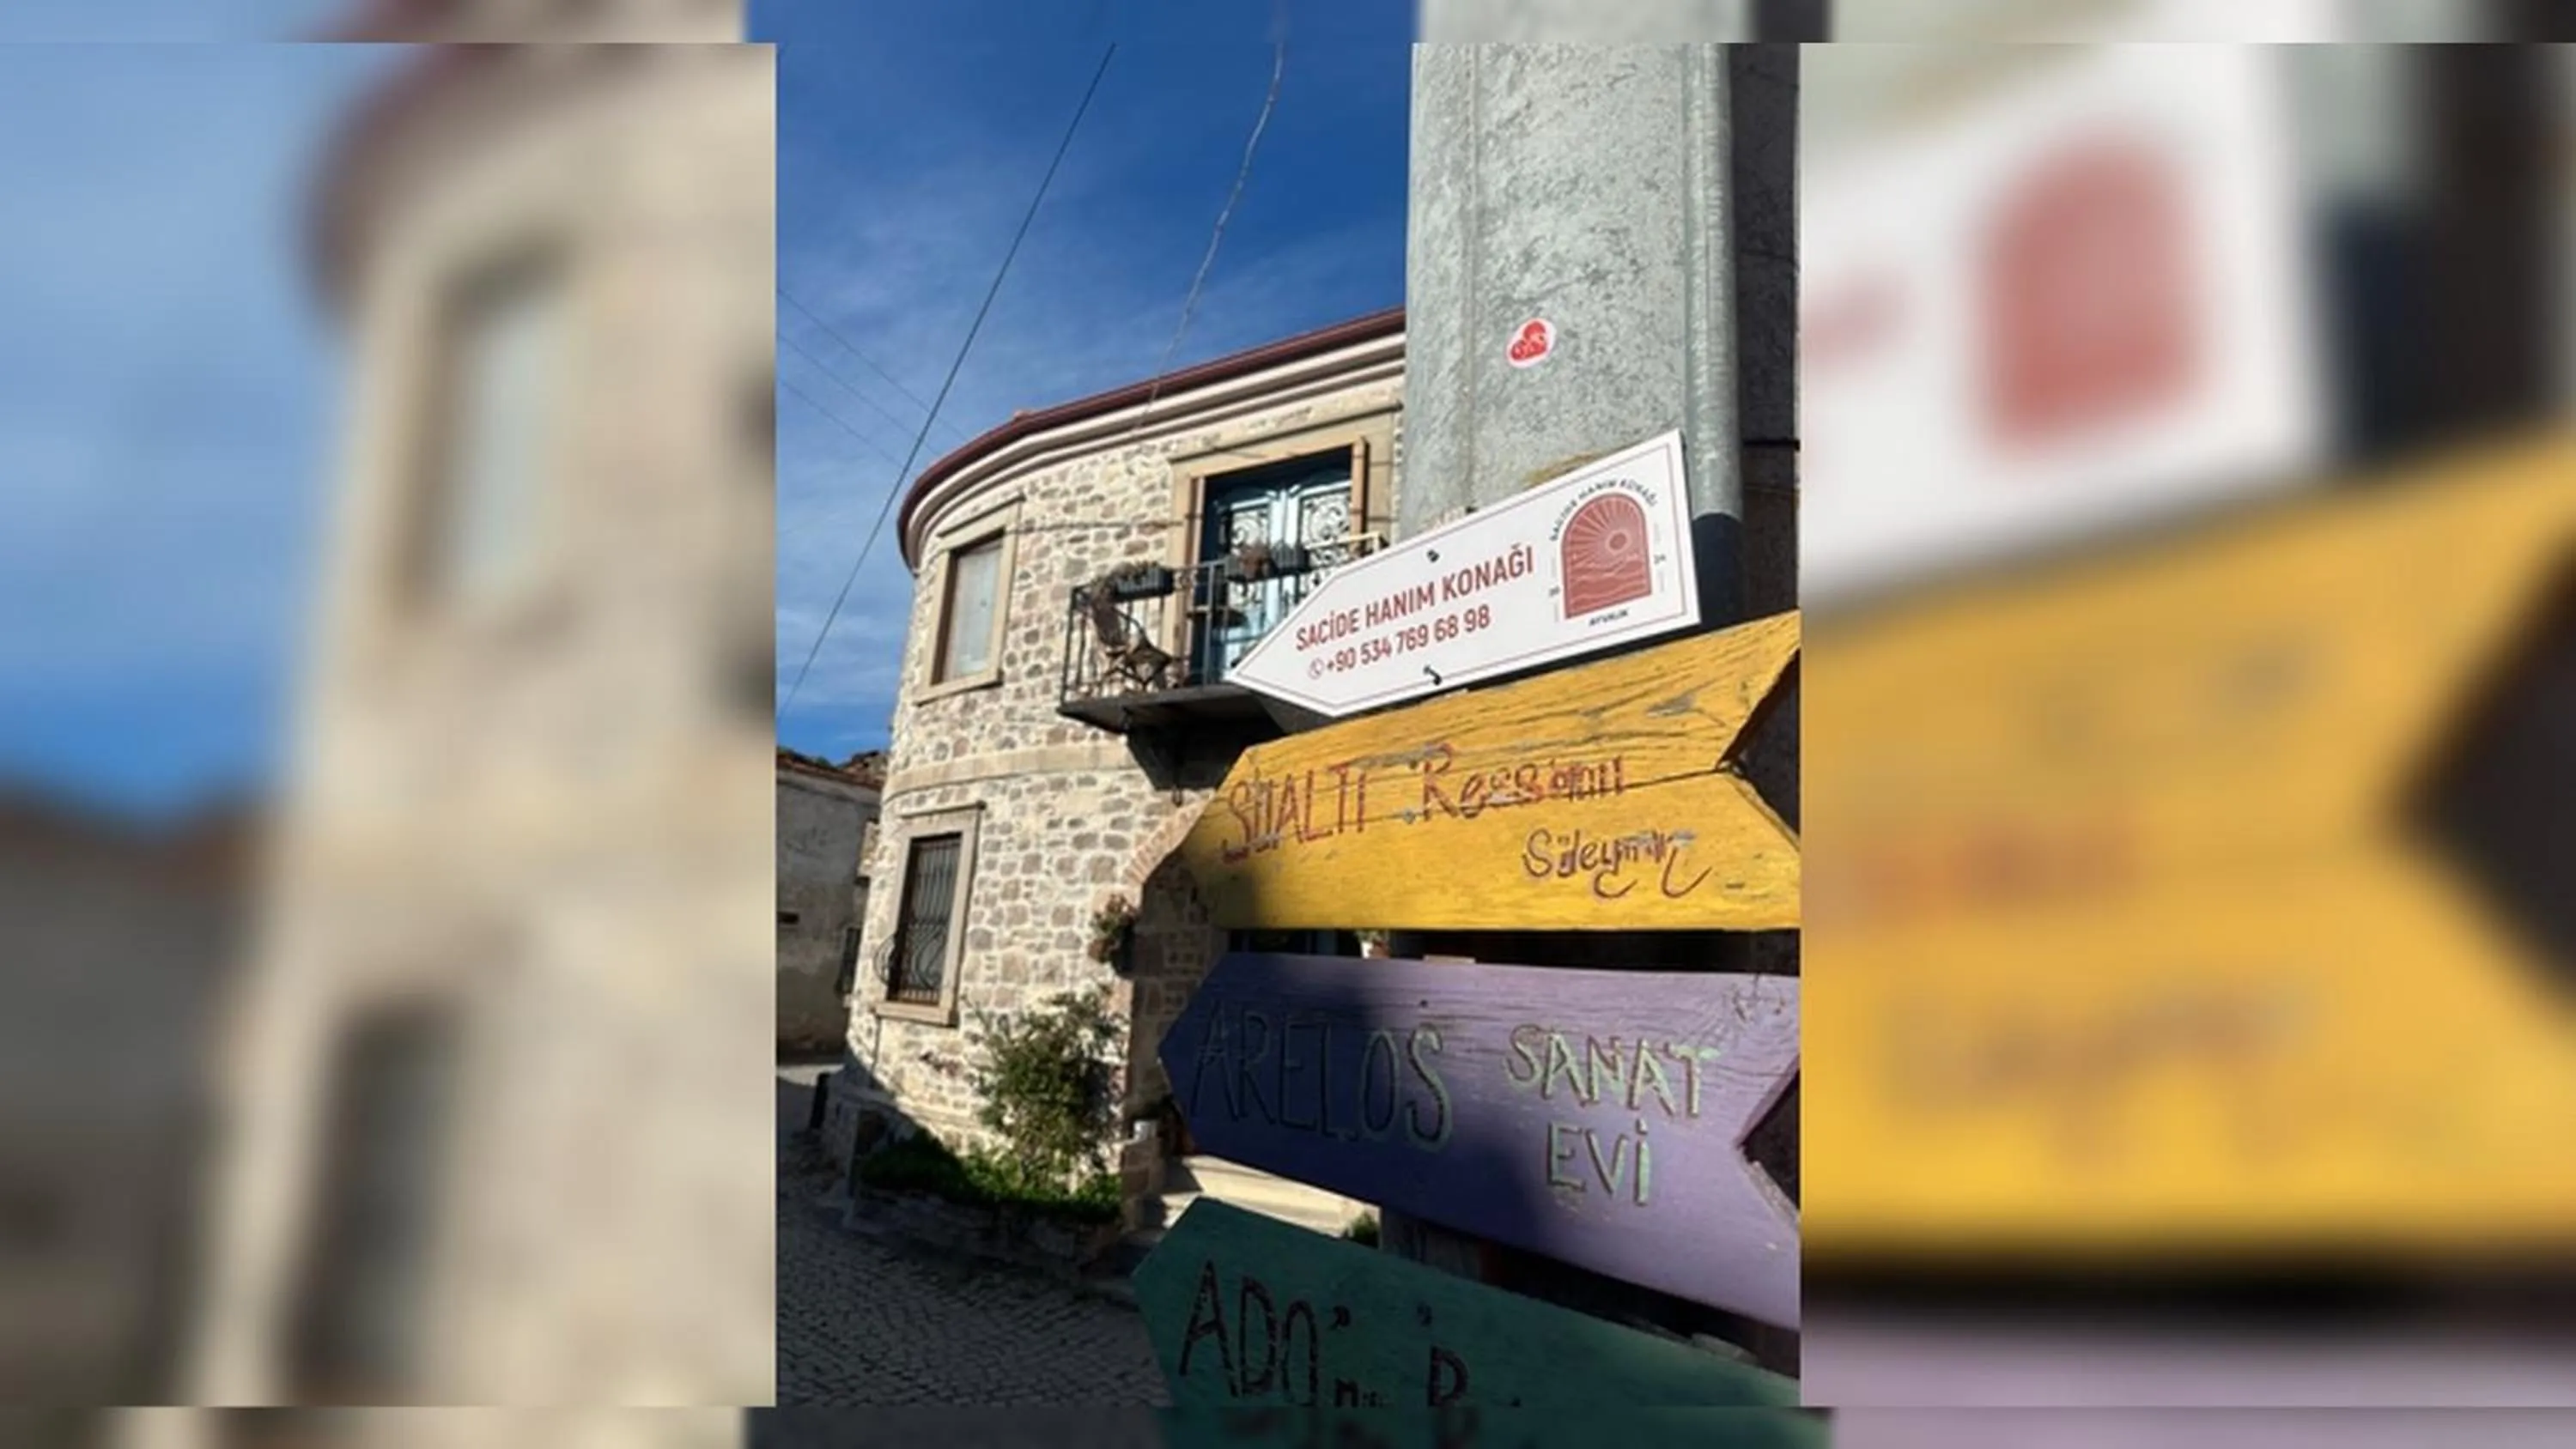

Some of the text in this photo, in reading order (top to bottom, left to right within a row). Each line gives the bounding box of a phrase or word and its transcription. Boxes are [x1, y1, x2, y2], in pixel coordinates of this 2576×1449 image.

[1296, 542, 1534, 652] SACİDE HANIM KONAĞI
[1326, 603, 1492, 672] +90 534 769 68 98
[1189, 999, 1721, 1153] ARELOS SANAT
[1547, 1118, 1649, 1207] EVİ
